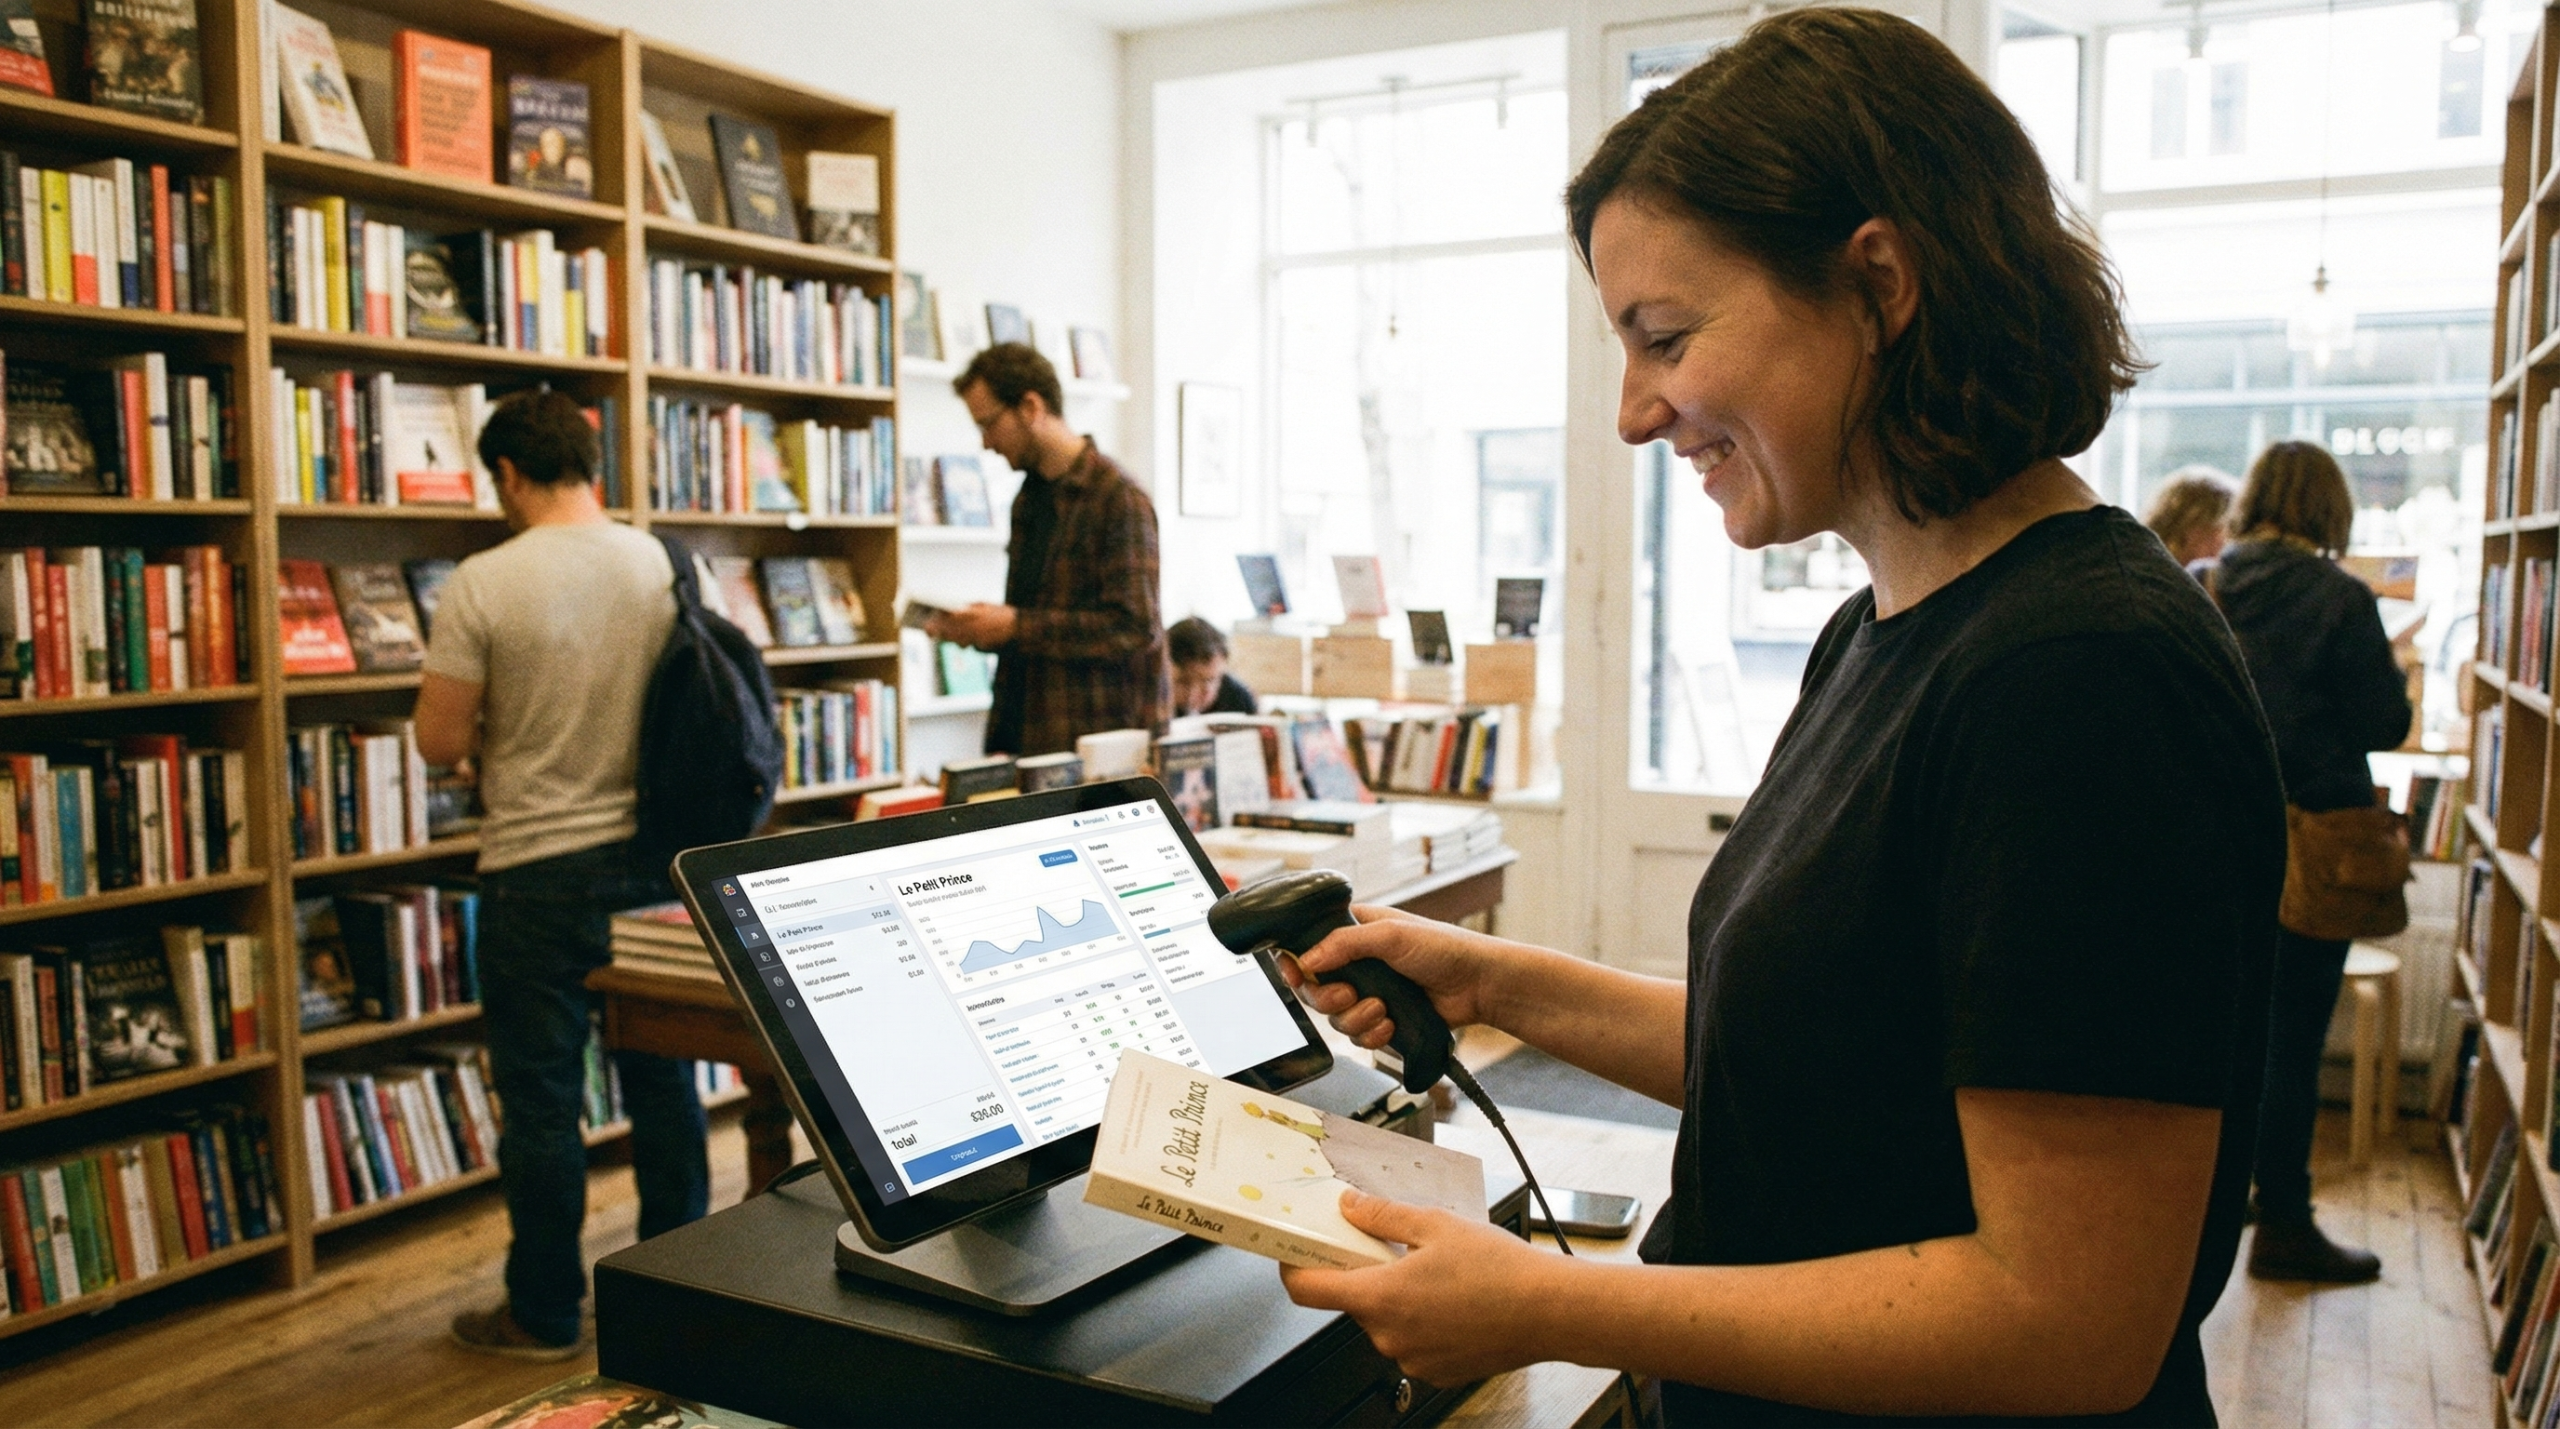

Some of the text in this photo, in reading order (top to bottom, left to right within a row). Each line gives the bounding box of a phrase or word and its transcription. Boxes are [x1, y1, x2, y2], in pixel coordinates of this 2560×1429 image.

[898, 885, 914, 896] Le
[938, 873, 973, 888] Prince
[1160, 1080, 1209, 1188] Le Petit Prince
[1136, 1194, 1224, 1234] Le Petit Prince
